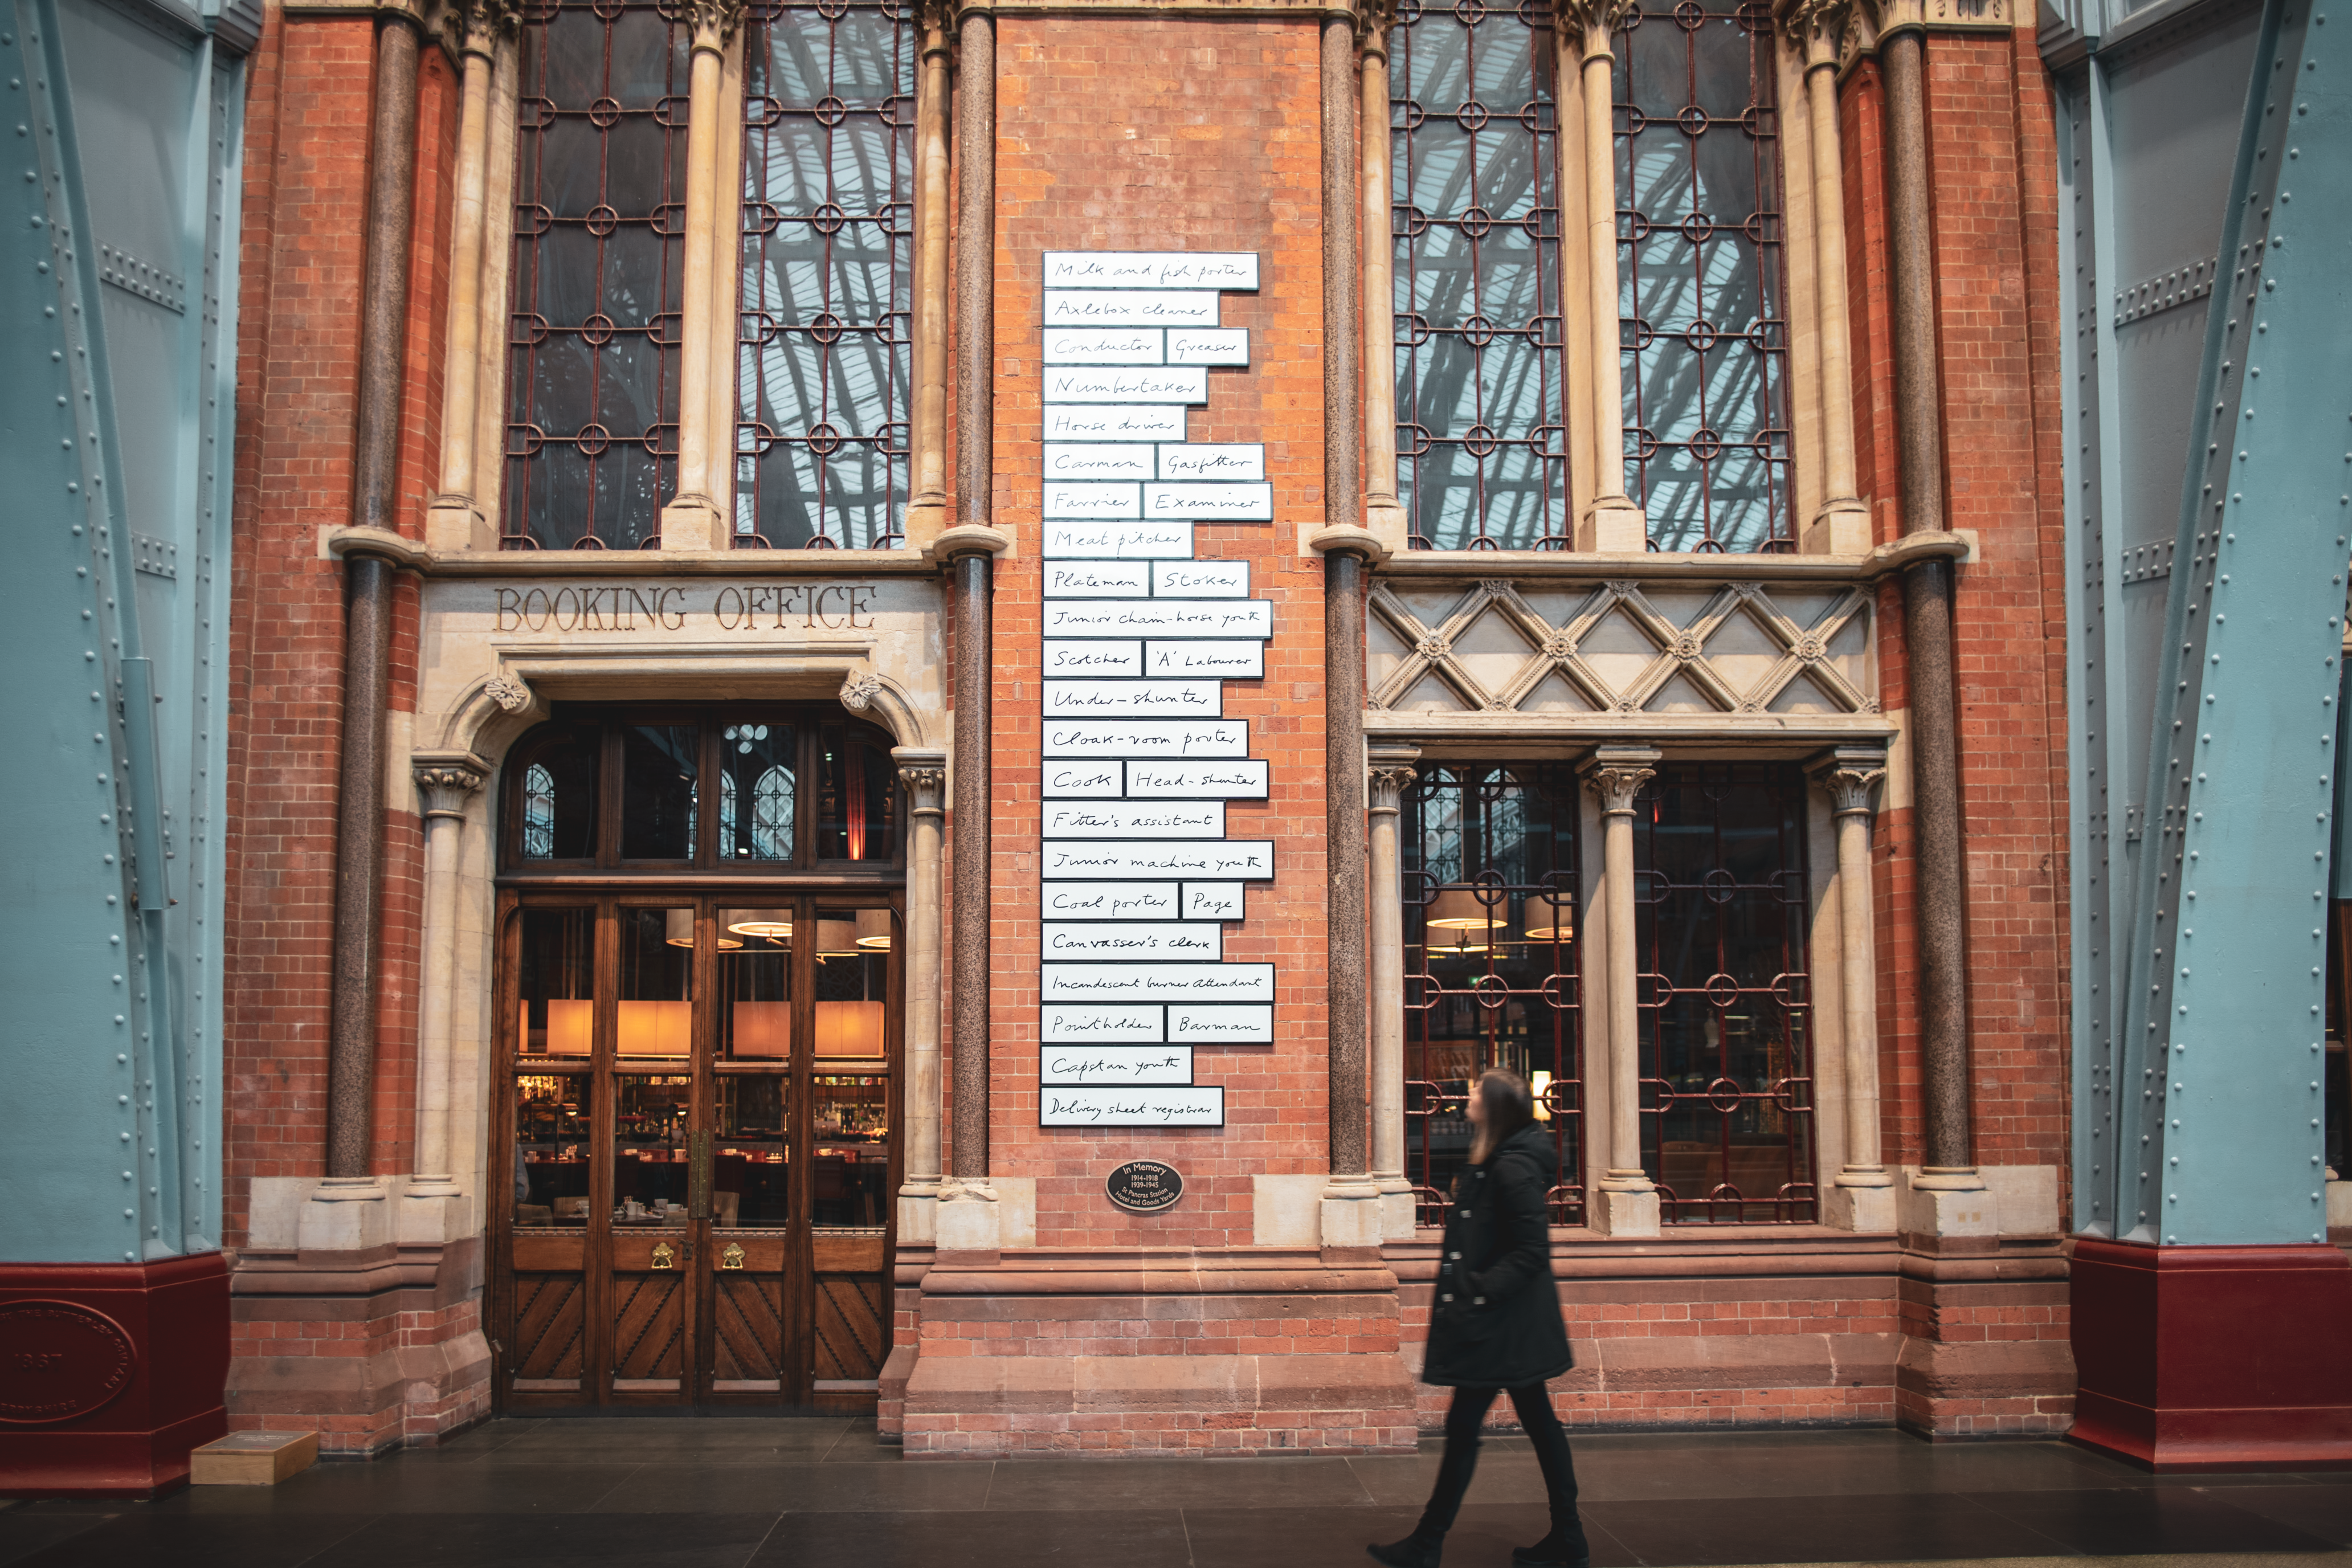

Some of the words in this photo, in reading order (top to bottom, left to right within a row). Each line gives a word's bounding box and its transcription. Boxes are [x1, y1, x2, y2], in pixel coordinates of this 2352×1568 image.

[1055, 260, 1104, 276] Milk
[1113, 264, 1152, 276] and
[1159, 260, 1191, 285] fish
[1197, 264, 1247, 283] porter
[1055, 300, 1131, 316] Axlebox
[1142, 303, 1208, 316] cleaner
[1055, 337, 1153, 354] Conductor
[1175, 339, 1237, 360] Greaser
[1055, 376, 1196, 394] Numbertaker
[1055, 415, 1106, 431] Horse
[1118, 414, 1175, 430] driver
[1055, 454, 1144, 469] Carman
[1168, 453, 1253, 474] Gasfitter
[1055, 492, 1129, 509] Farrier
[1155, 492, 1260, 509] Examiner
[1055, 530, 1109, 546] Meat
[1117, 531, 1181, 556] pitcher
[1054, 571, 1138, 588] Plateman
[1163, 572, 1238, 587] Stoker
[492, 587, 687, 632] BOOKING
[713, 586, 876, 631] OFFICE
[1053, 610, 1111, 625] Junior
[1118, 610, 1213, 624] chain-horse
[1221, 611, 1260, 628] youth
[1054, 651, 1130, 666] Scotcher
[1185, 655, 1252, 667] Labourer
[1182, 728, 1236, 754] porter
[1054, 771, 1112, 787] Cook
[1131, 814, 1213, 826] assistant
[1053, 852, 1118, 867] Junior
[1130, 854, 1206, 869] machine
[1215, 855, 1262, 872] youth
[1052, 893, 1104, 909] Coal
[1112, 893, 1167, 917] porter
[1193, 892, 1232, 914] Page
[1168, 936, 1210, 949] clerk
[1052, 975, 1140, 990] Incandescent
[1147, 976, 1189, 988] burner
[1052, 1015, 1152, 1034] Pointholder
[1178, 1016, 1261, 1032] Barman
[1051, 1057, 1128, 1081] Capstan
[1134, 1055, 1181, 1076] youth
[1049, 1097, 1101, 1121] Delivery
[1107, 1101, 1147, 1114] sheet
[1152, 1103, 1212, 1121] registrar
[1133, 1163, 1167, 1176] Memory
[1115, 1190, 1130, 1203] Hotel
[1160, 1191, 1175, 1202] Yards
[1128, 1190, 1149, 1198] Pancras
[1149, 1187, 1168, 1198] Station
